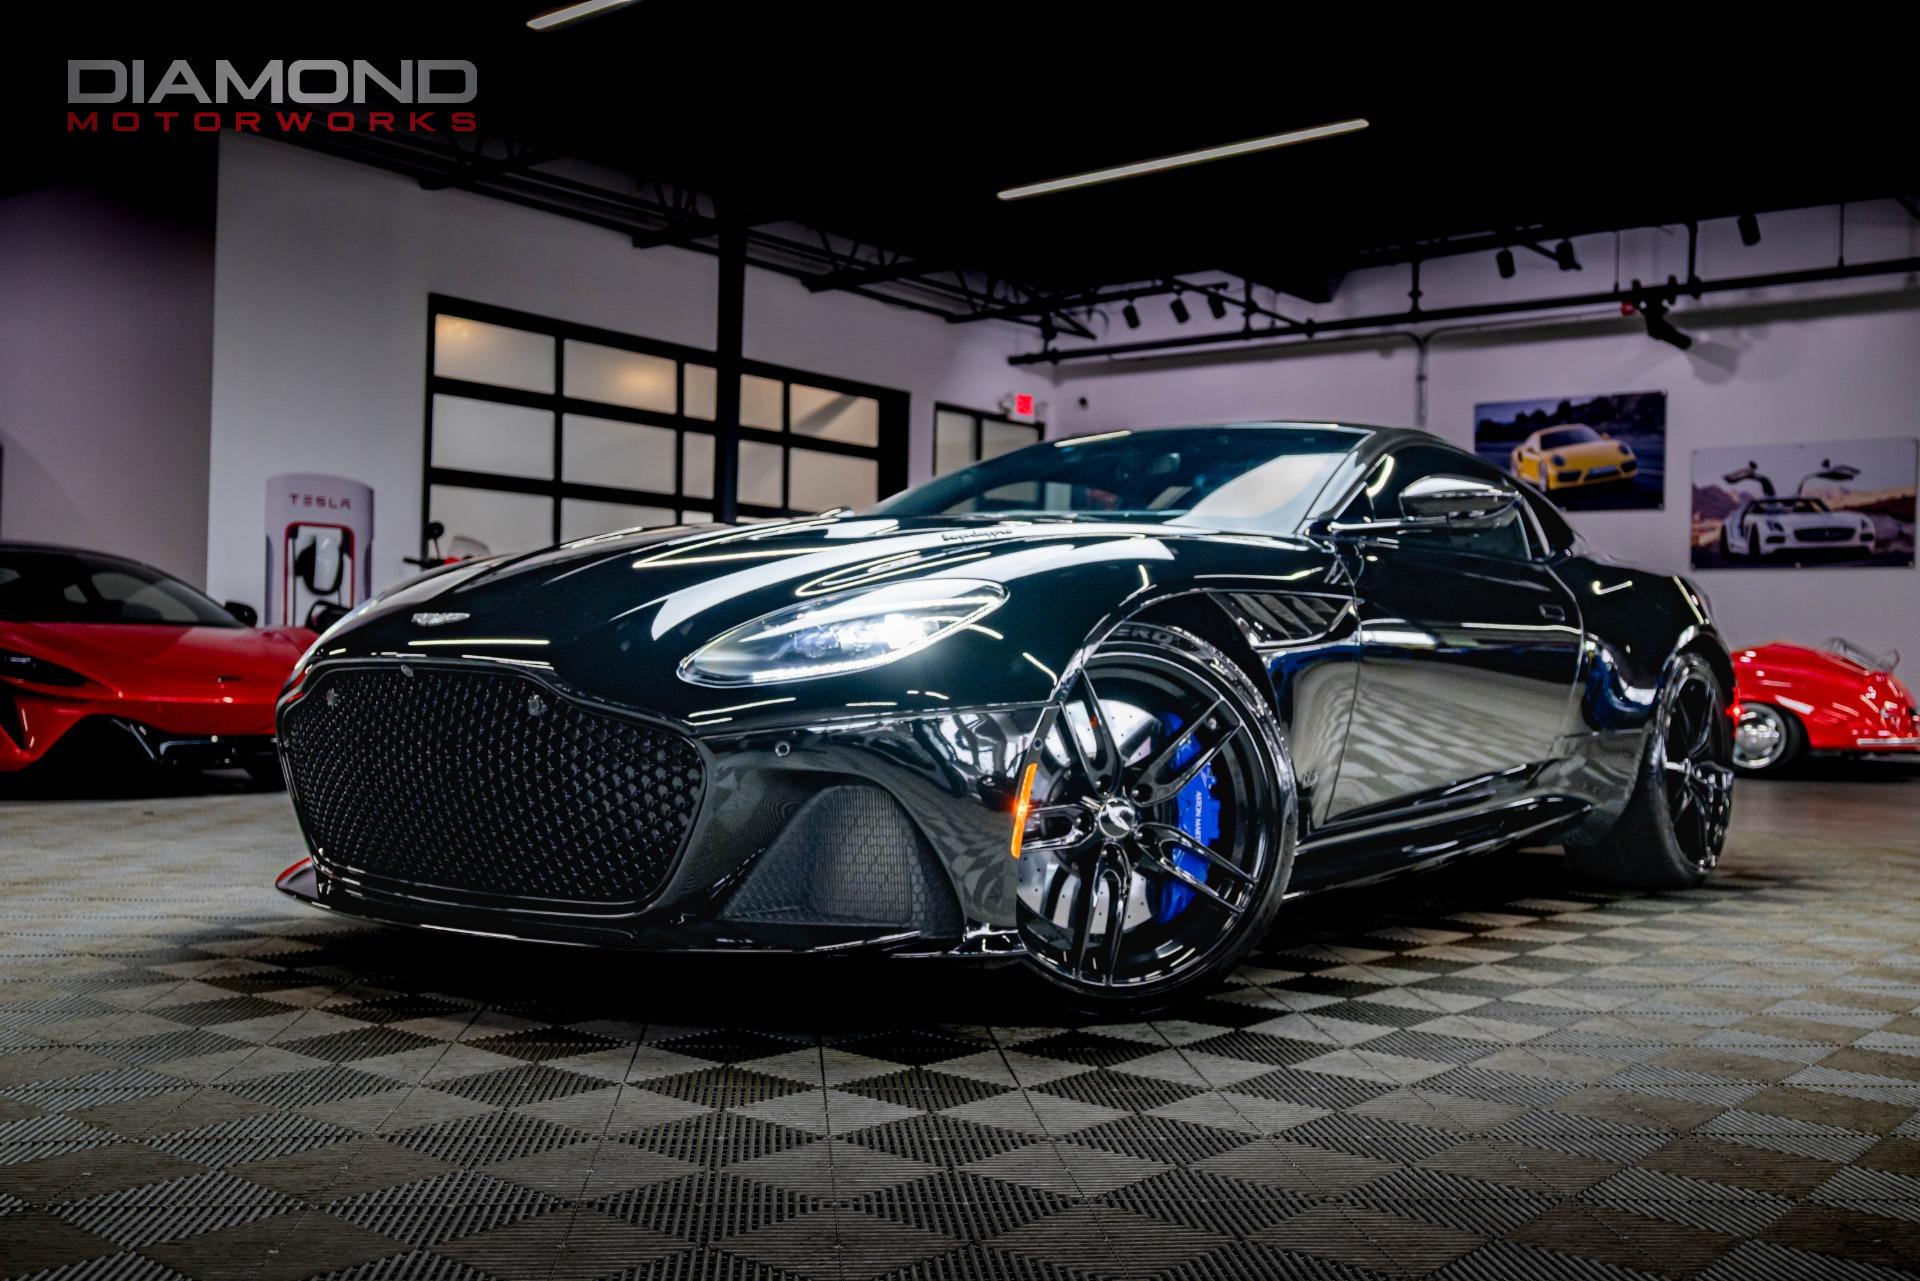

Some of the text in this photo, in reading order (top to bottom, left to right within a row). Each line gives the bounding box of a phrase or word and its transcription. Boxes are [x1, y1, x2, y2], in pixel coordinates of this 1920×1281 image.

[289, 493, 351, 509] TESLA
[1111, 625, 1174, 645] ERO
[1194, 790, 1203, 843] ASTON MART
